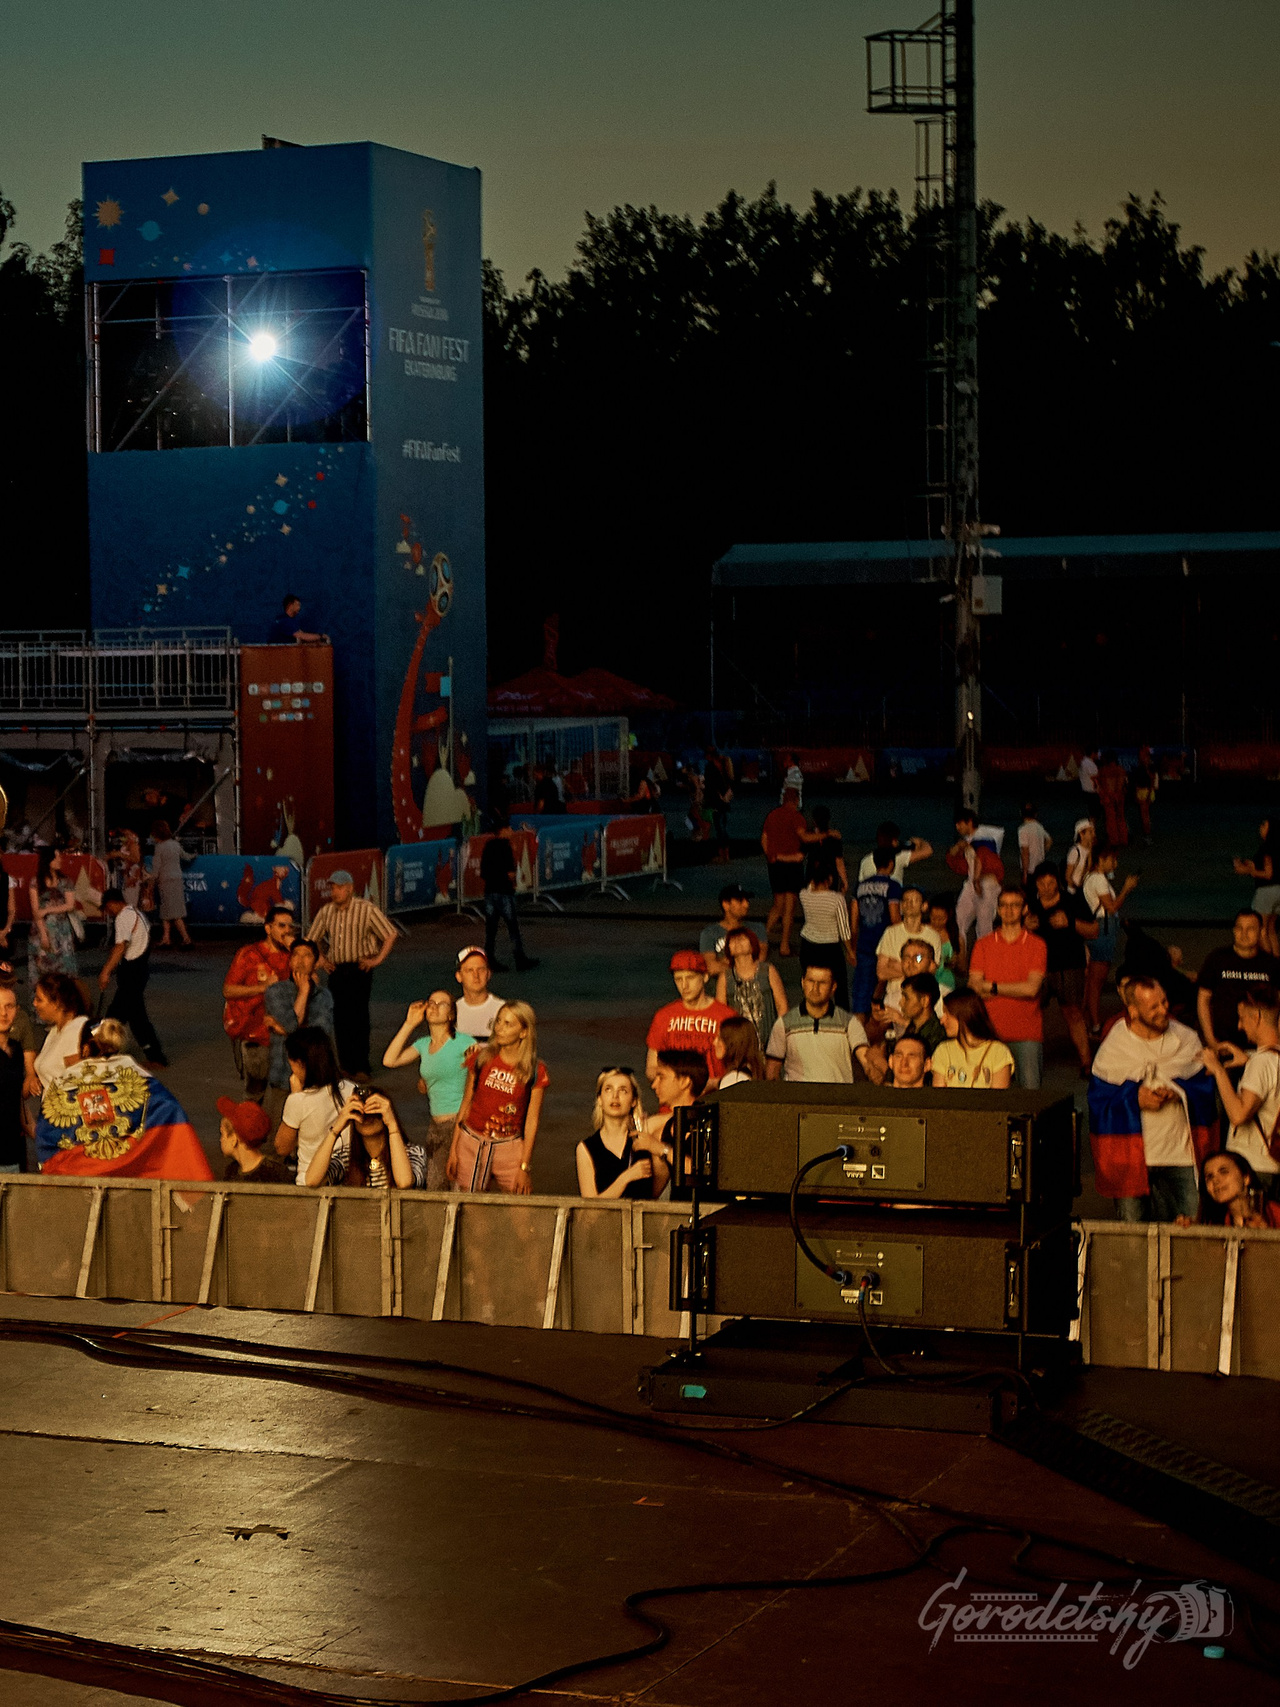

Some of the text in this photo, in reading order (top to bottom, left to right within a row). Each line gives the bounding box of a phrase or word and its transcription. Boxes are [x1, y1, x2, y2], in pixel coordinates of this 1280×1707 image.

[389, 327, 470, 364] FIFA FAN FEST
[667, 1015, 717, 1034] ЗАНЕСЕН
